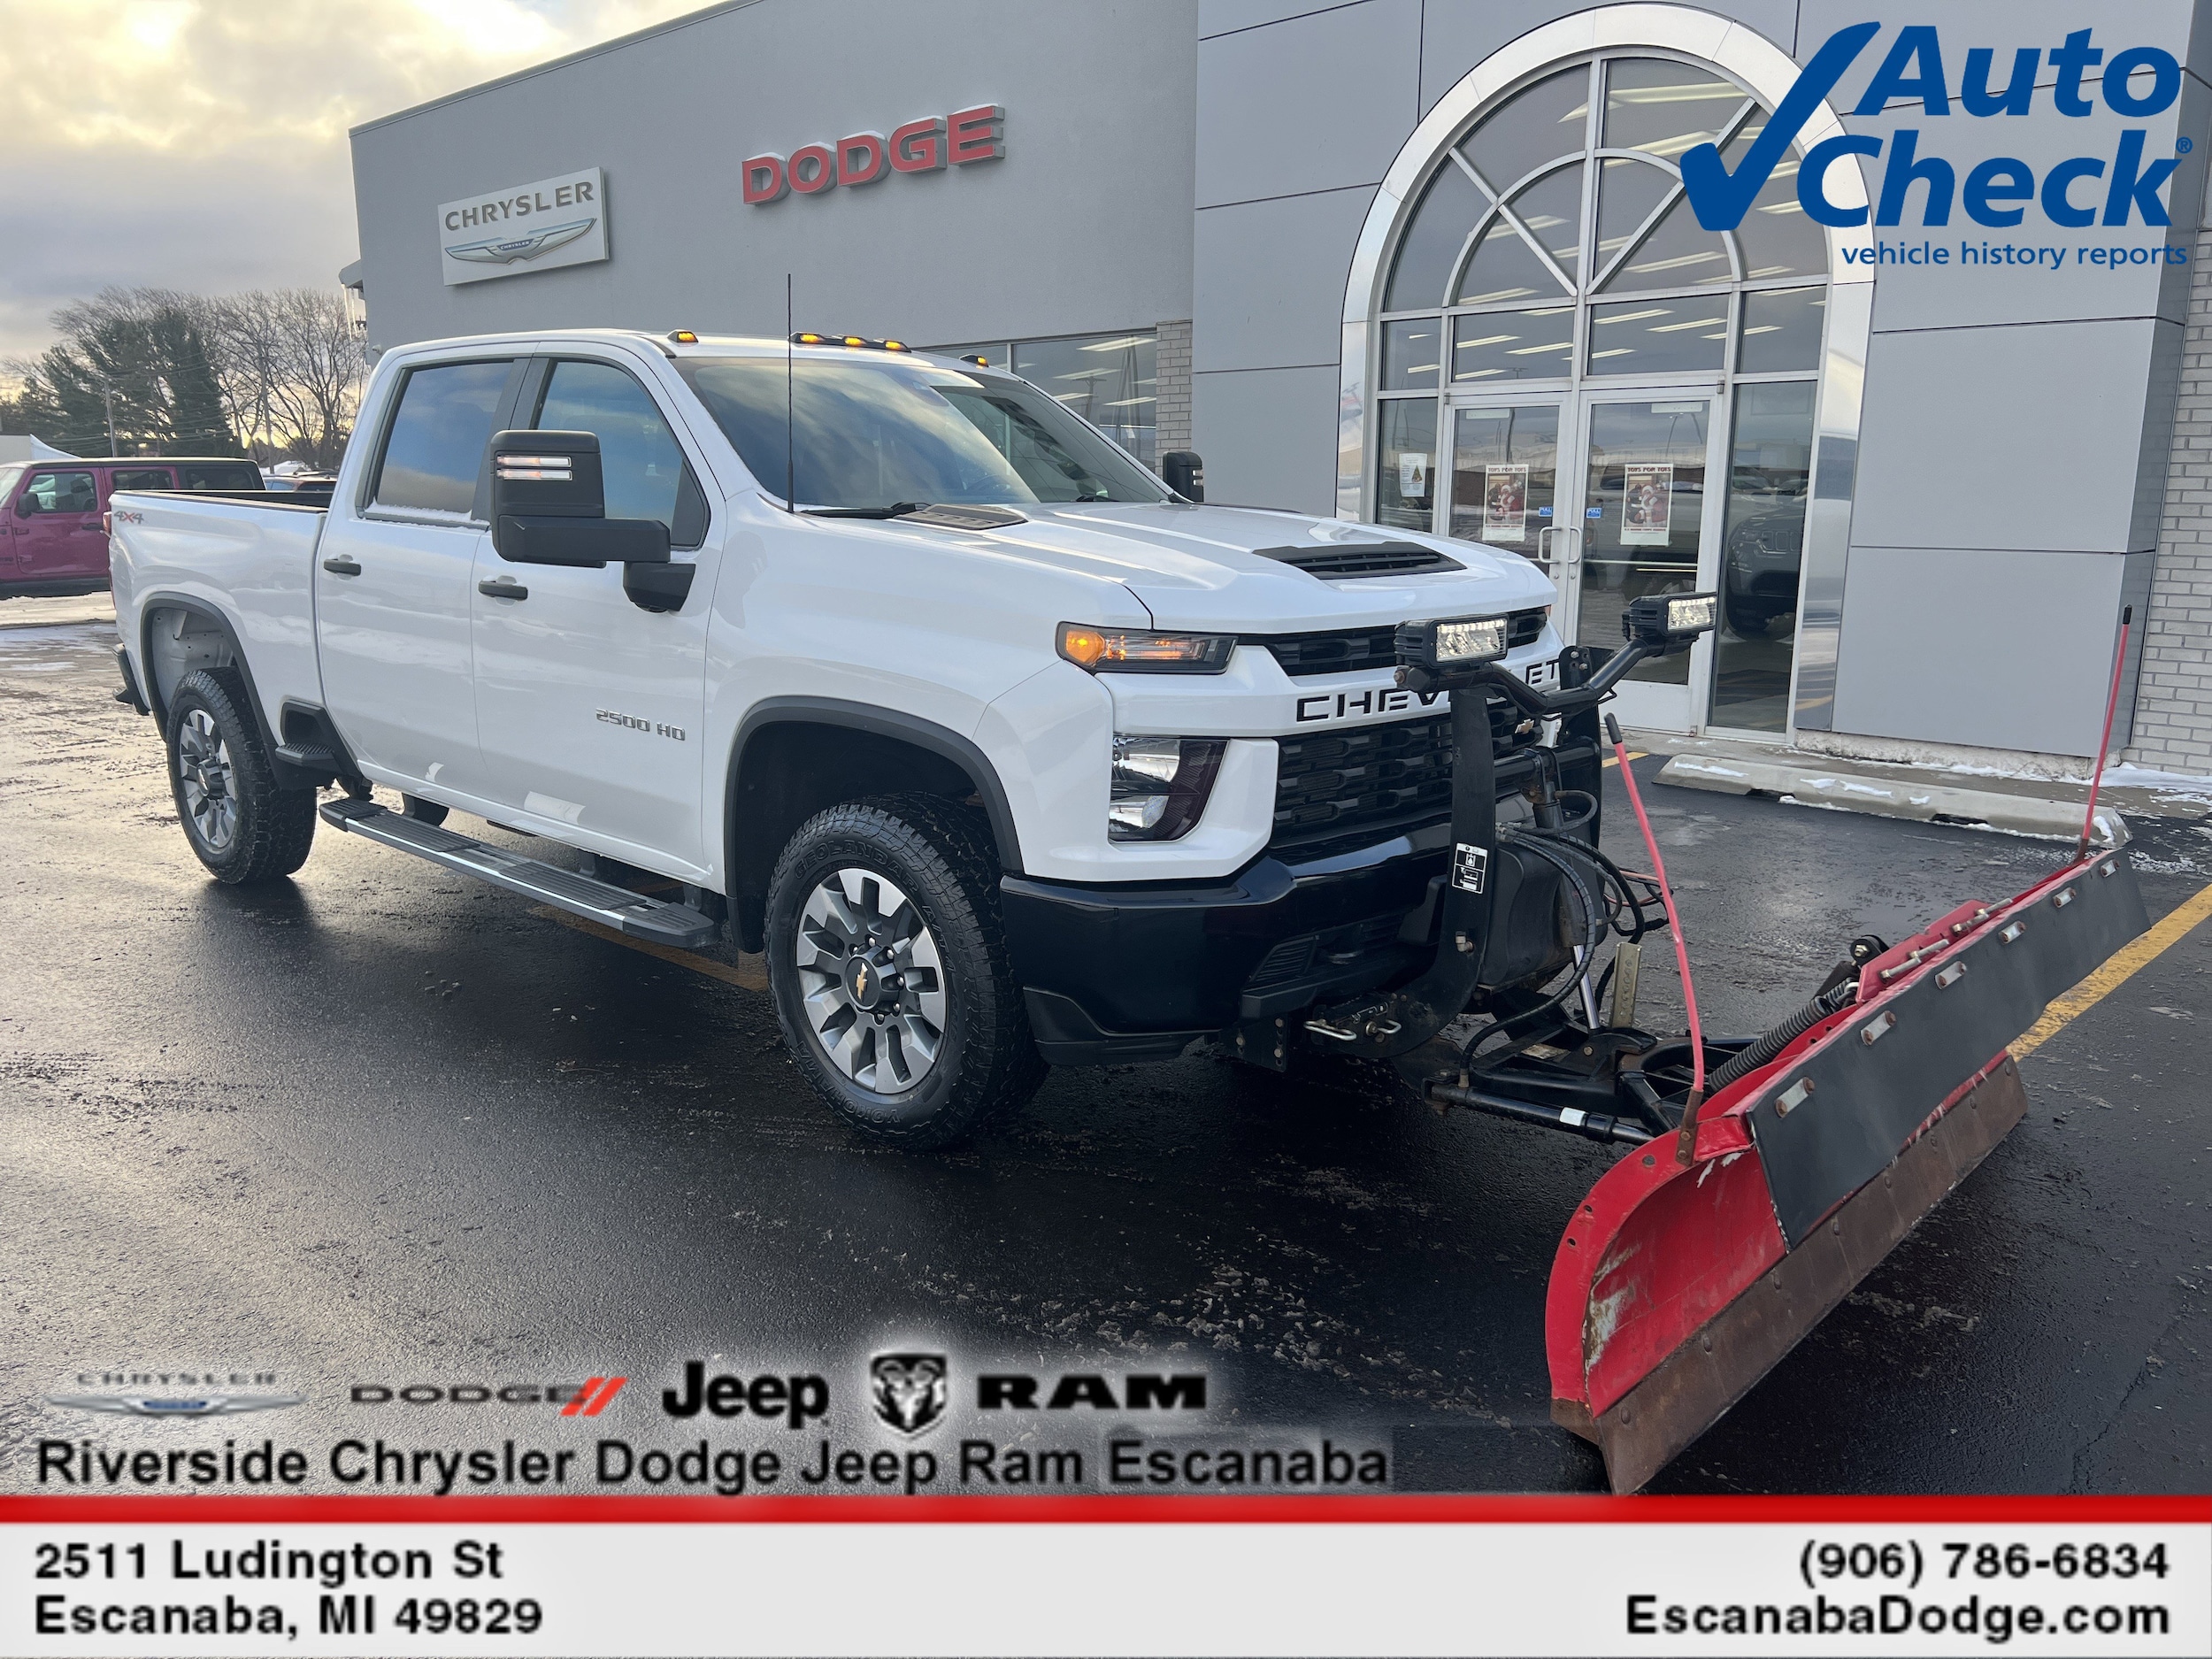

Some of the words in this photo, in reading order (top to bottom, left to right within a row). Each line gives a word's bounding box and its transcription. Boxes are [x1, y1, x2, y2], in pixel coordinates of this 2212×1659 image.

[741, 104, 1005, 206] DODGE
[444, 180, 595, 233] CHRYSLER
[499, 240, 531, 251] CHRYSLER
[1296, 658, 1560, 722] CHEVET
[595, 707, 651, 733] 2500
[657, 721, 687, 741] HD
[795, 839, 919, 895] GEOLANDAR
[796, 1040, 901, 1124] YOKOHAMA
